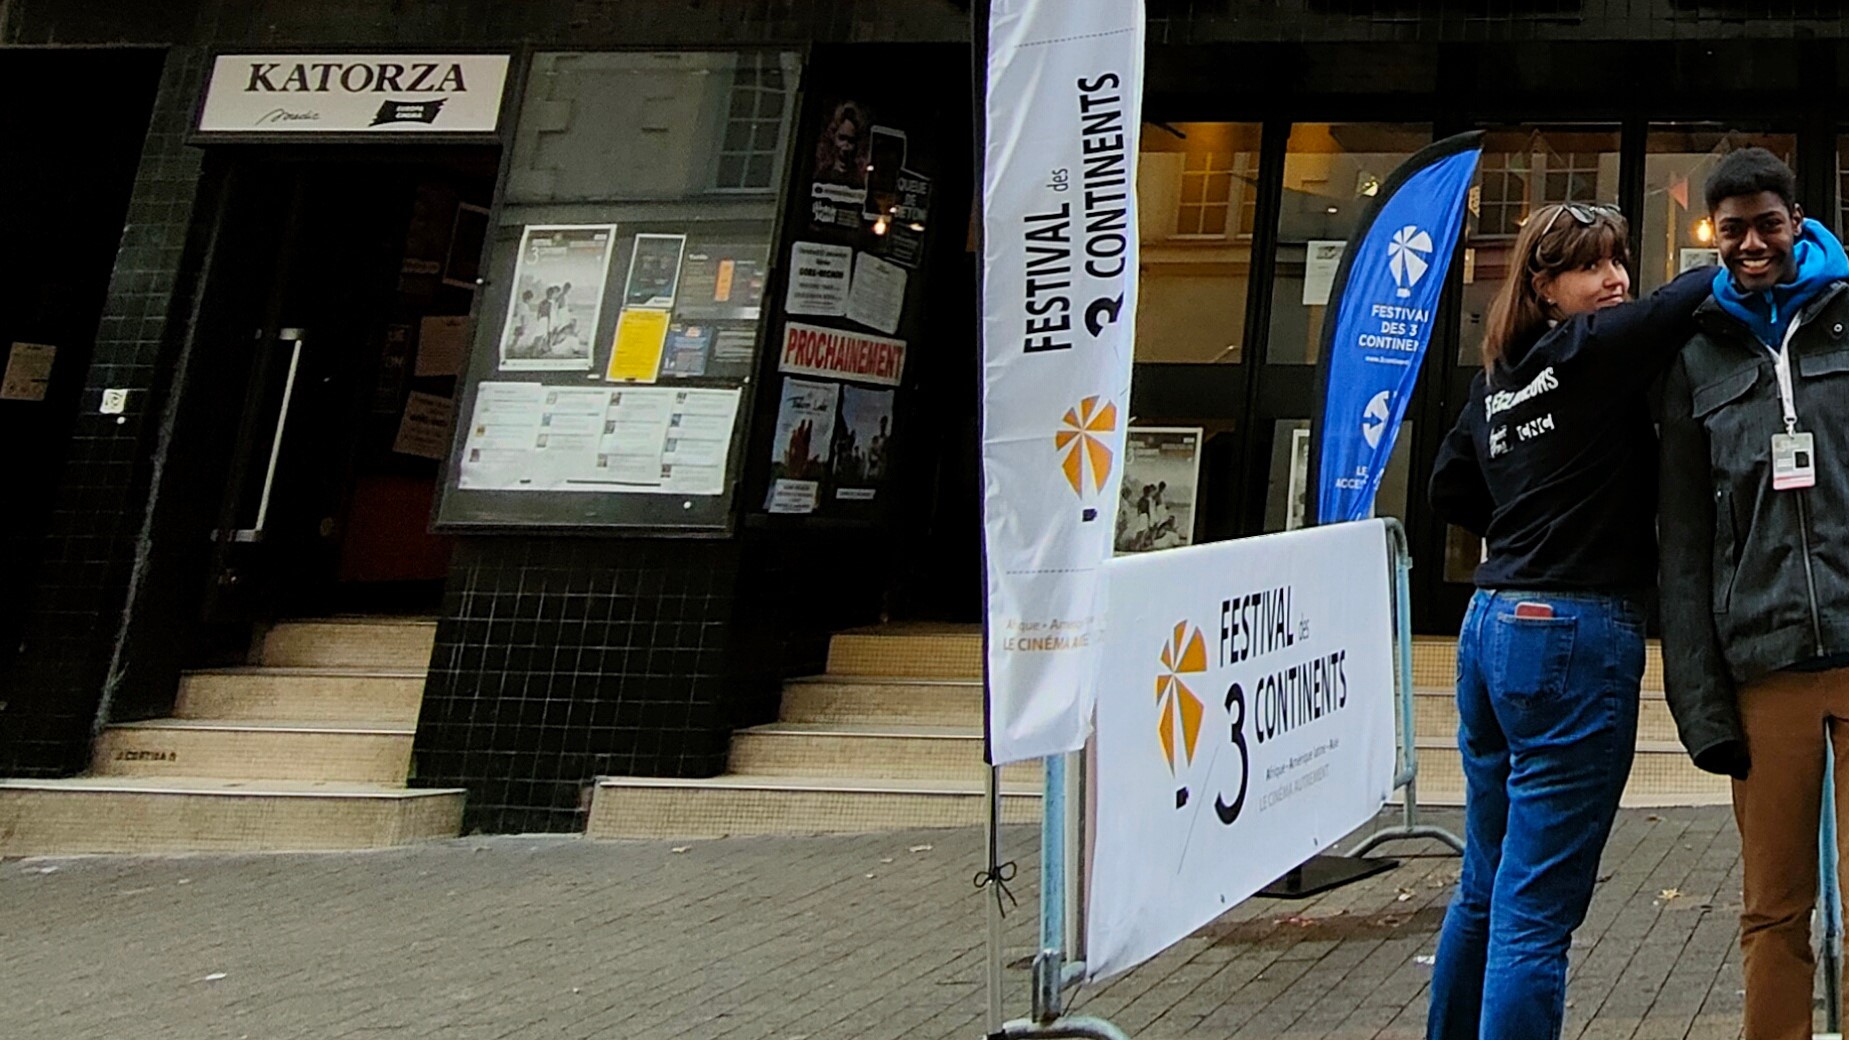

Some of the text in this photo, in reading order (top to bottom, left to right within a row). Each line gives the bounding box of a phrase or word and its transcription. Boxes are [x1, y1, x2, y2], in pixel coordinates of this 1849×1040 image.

[244, 63, 468, 93] KATORZA
[1077, 72, 1127, 280] CONTINENTS
[1023, 167, 1072, 355] FESTIVAL des
[784, 328, 904, 379] PROCHAINEMENT
[1381, 321, 1418, 337] DES 3
[1003, 637, 1014, 650] LE
[1220, 585, 1310, 668] FESTIVAL des
[1214, 649, 1347, 825] 3 CONTINENTS
[1258, 763, 1330, 812] LE CINÉMA AUTREMENT
